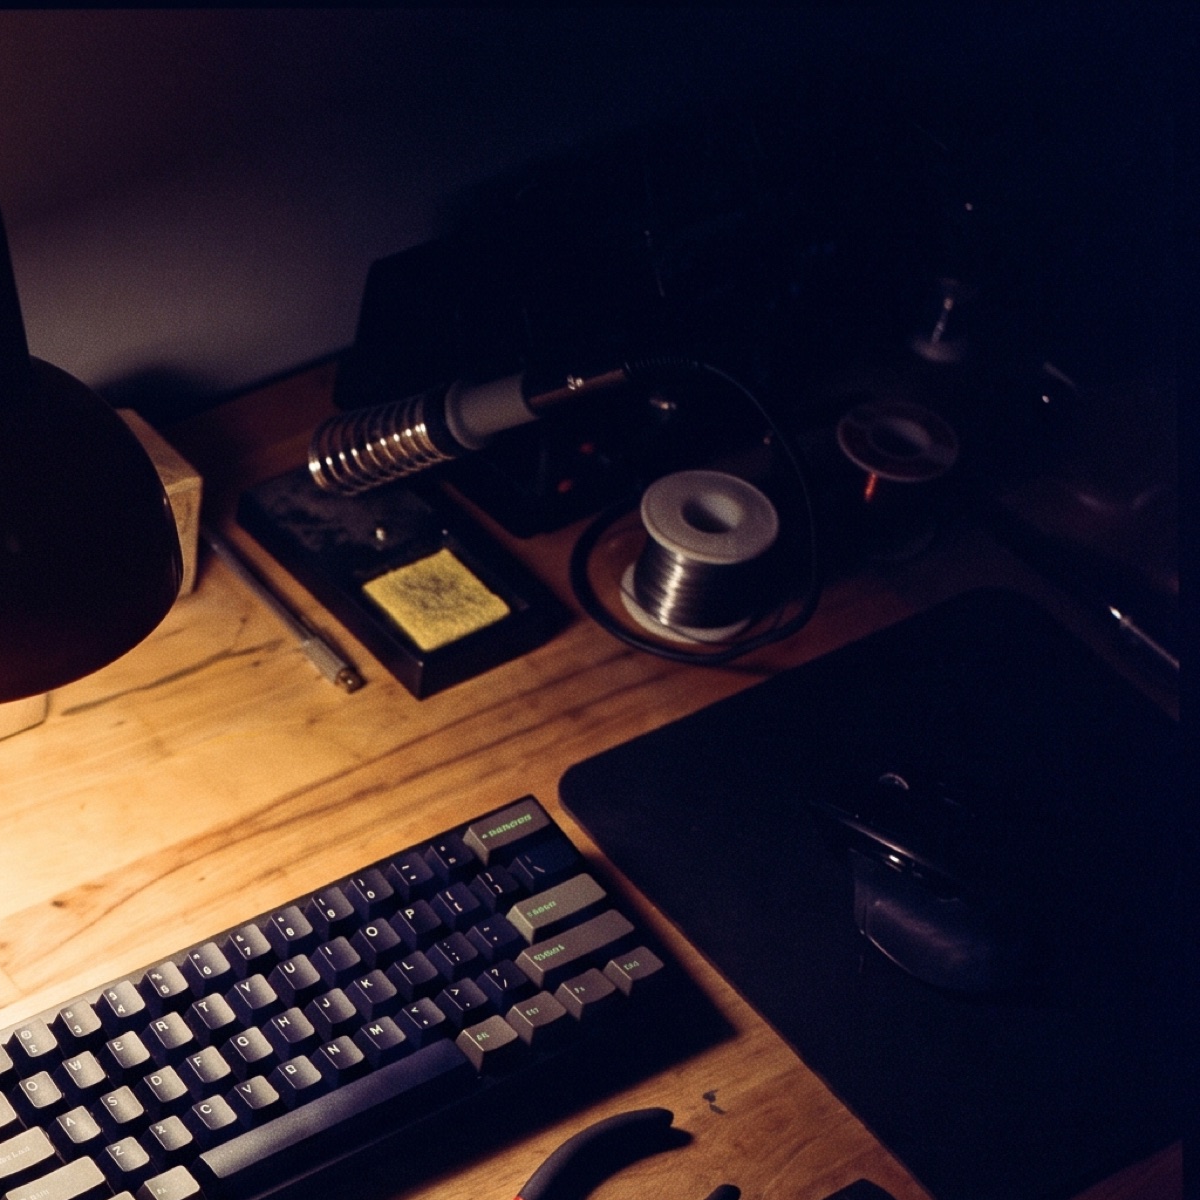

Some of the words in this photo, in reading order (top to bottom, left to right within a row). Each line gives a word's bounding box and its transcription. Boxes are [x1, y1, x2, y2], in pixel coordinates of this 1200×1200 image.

[68, 1060, 82, 1071] W
[112, 1041, 124, 1052] E
[198, 1001, 210, 1012] T
[284, 962, 296, 974] U
[366, 926, 378, 937] O
[404, 908, 415, 920] P
[107, 1096, 119, 1106] S
[150, 1075, 162, 1086] D
[192, 1056, 202, 1067] F
[278, 1016, 291, 1028] H
[322, 998, 331, 1008] J
[360, 978, 374, 988] K
[402, 962, 414, 970] L
[112, 1146, 125, 1156] Z
[200, 1104, 212, 1114] C
[240, 1084, 252, 1094] V
[327, 1044, 341, 1056] N
[369, 1024, 384, 1036] M
